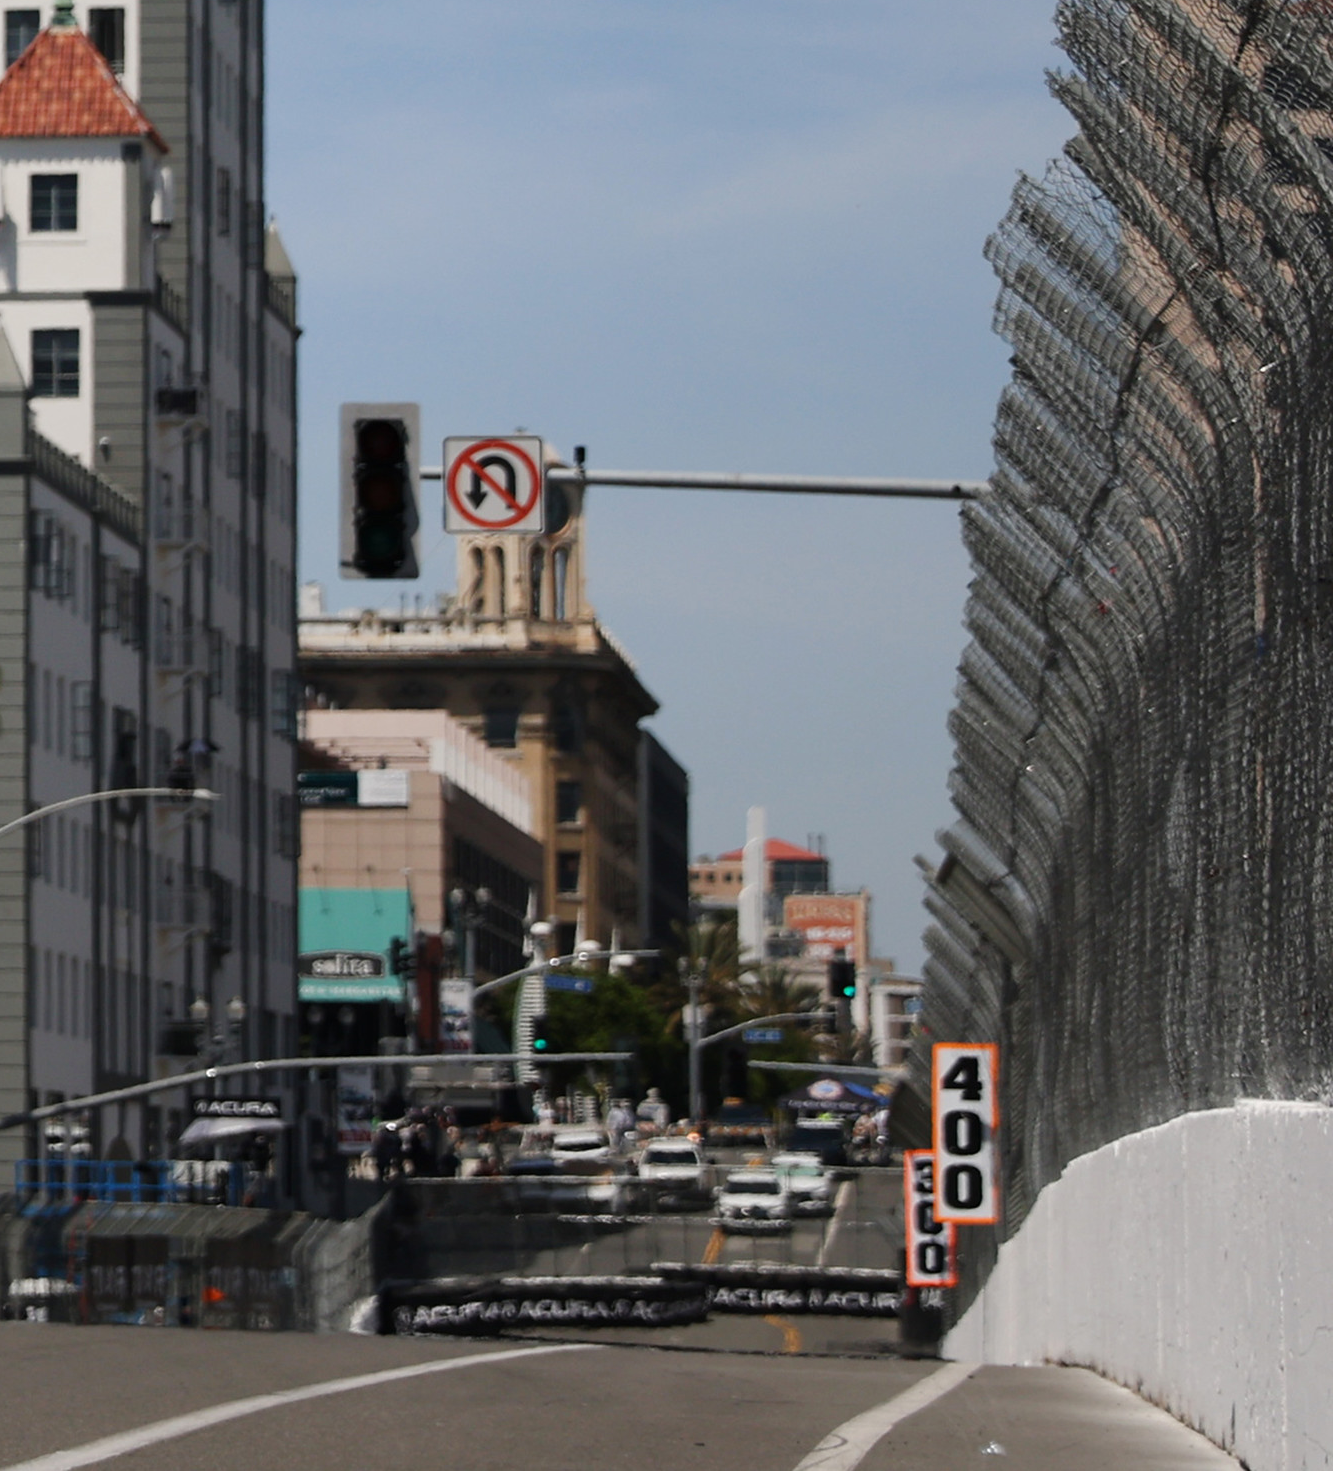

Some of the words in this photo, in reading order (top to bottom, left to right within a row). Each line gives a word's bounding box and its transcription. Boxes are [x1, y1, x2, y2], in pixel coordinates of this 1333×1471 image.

[208, 1101, 279, 1114] ACURA
[941, 1056, 983, 1210] 400
[823, 1290, 903, 1309] ACUR
